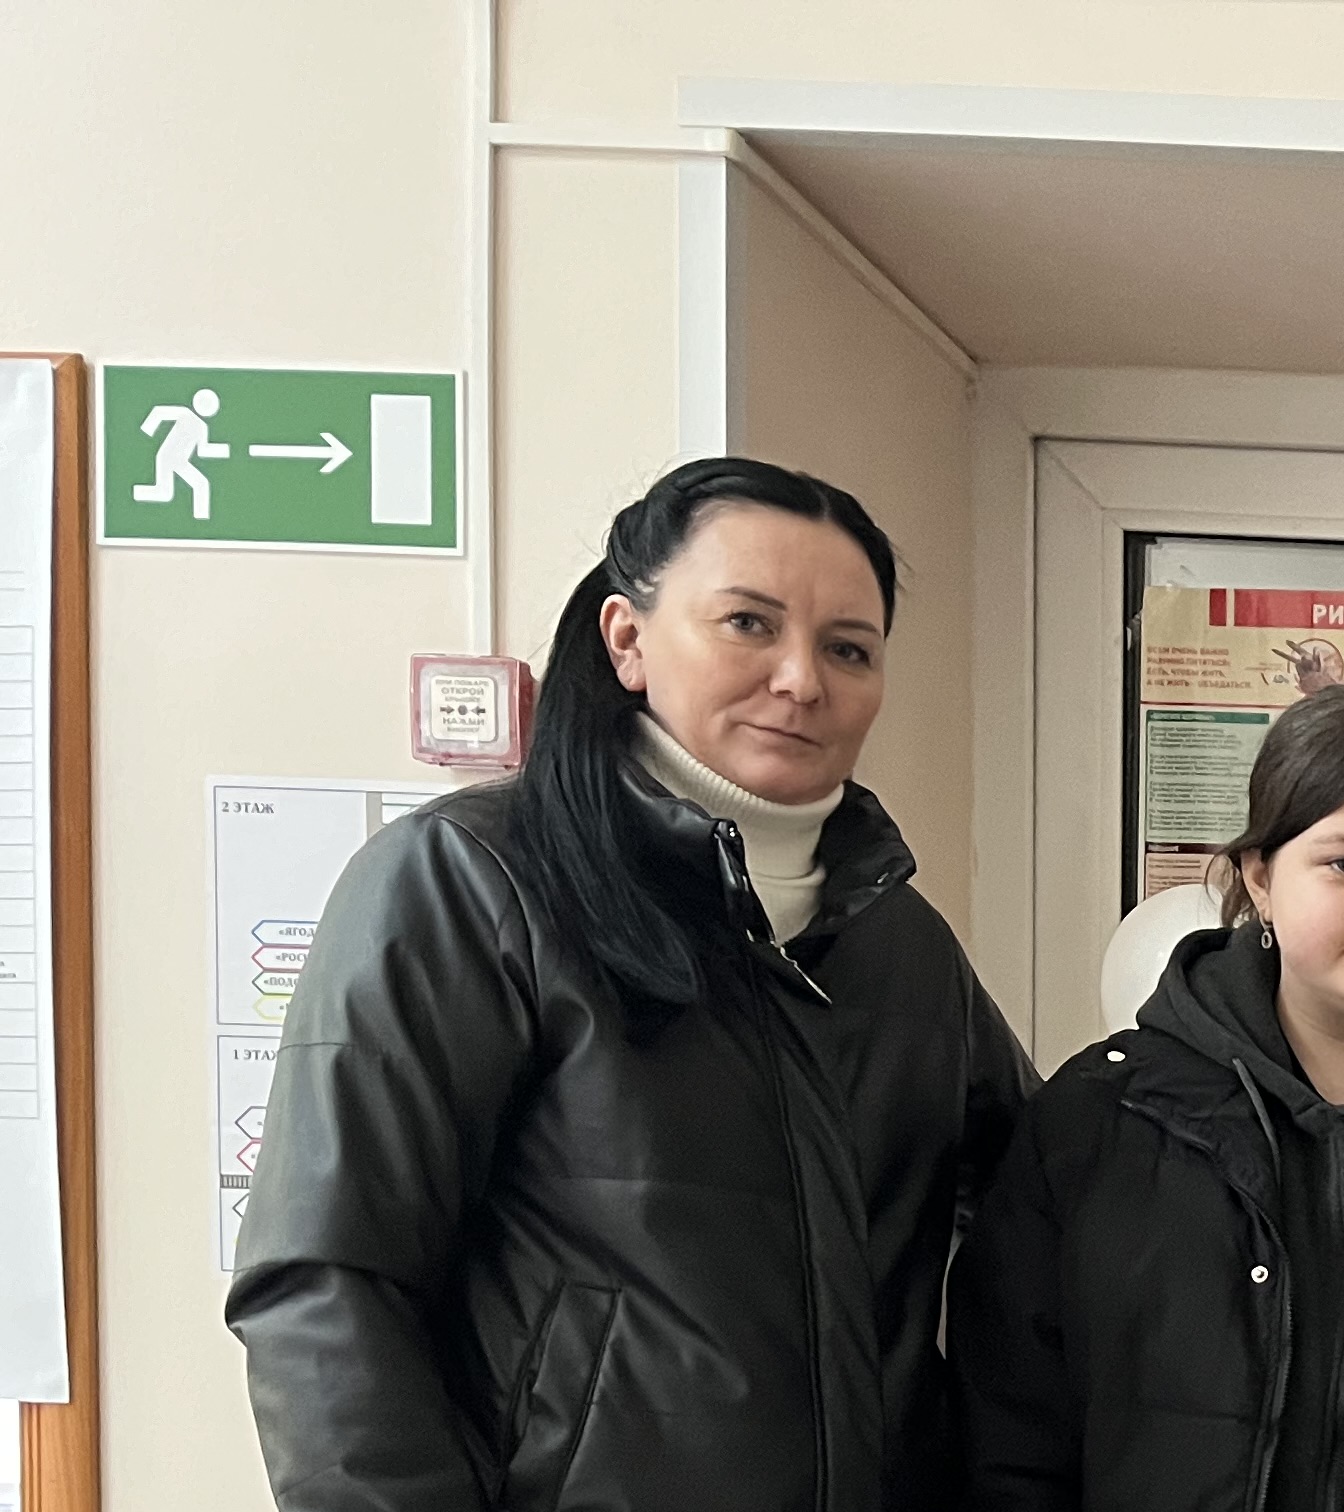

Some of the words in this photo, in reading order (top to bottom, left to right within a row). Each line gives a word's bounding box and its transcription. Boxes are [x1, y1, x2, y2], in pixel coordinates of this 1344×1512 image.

[441, 687, 485, 696] ОТКРОЙ
[221, 801, 229, 812] 2
[233, 802, 274, 814] ЭТАЖ
[279, 928, 315, 938] «ЯГОД
[233, 1049, 238, 1060] 1
